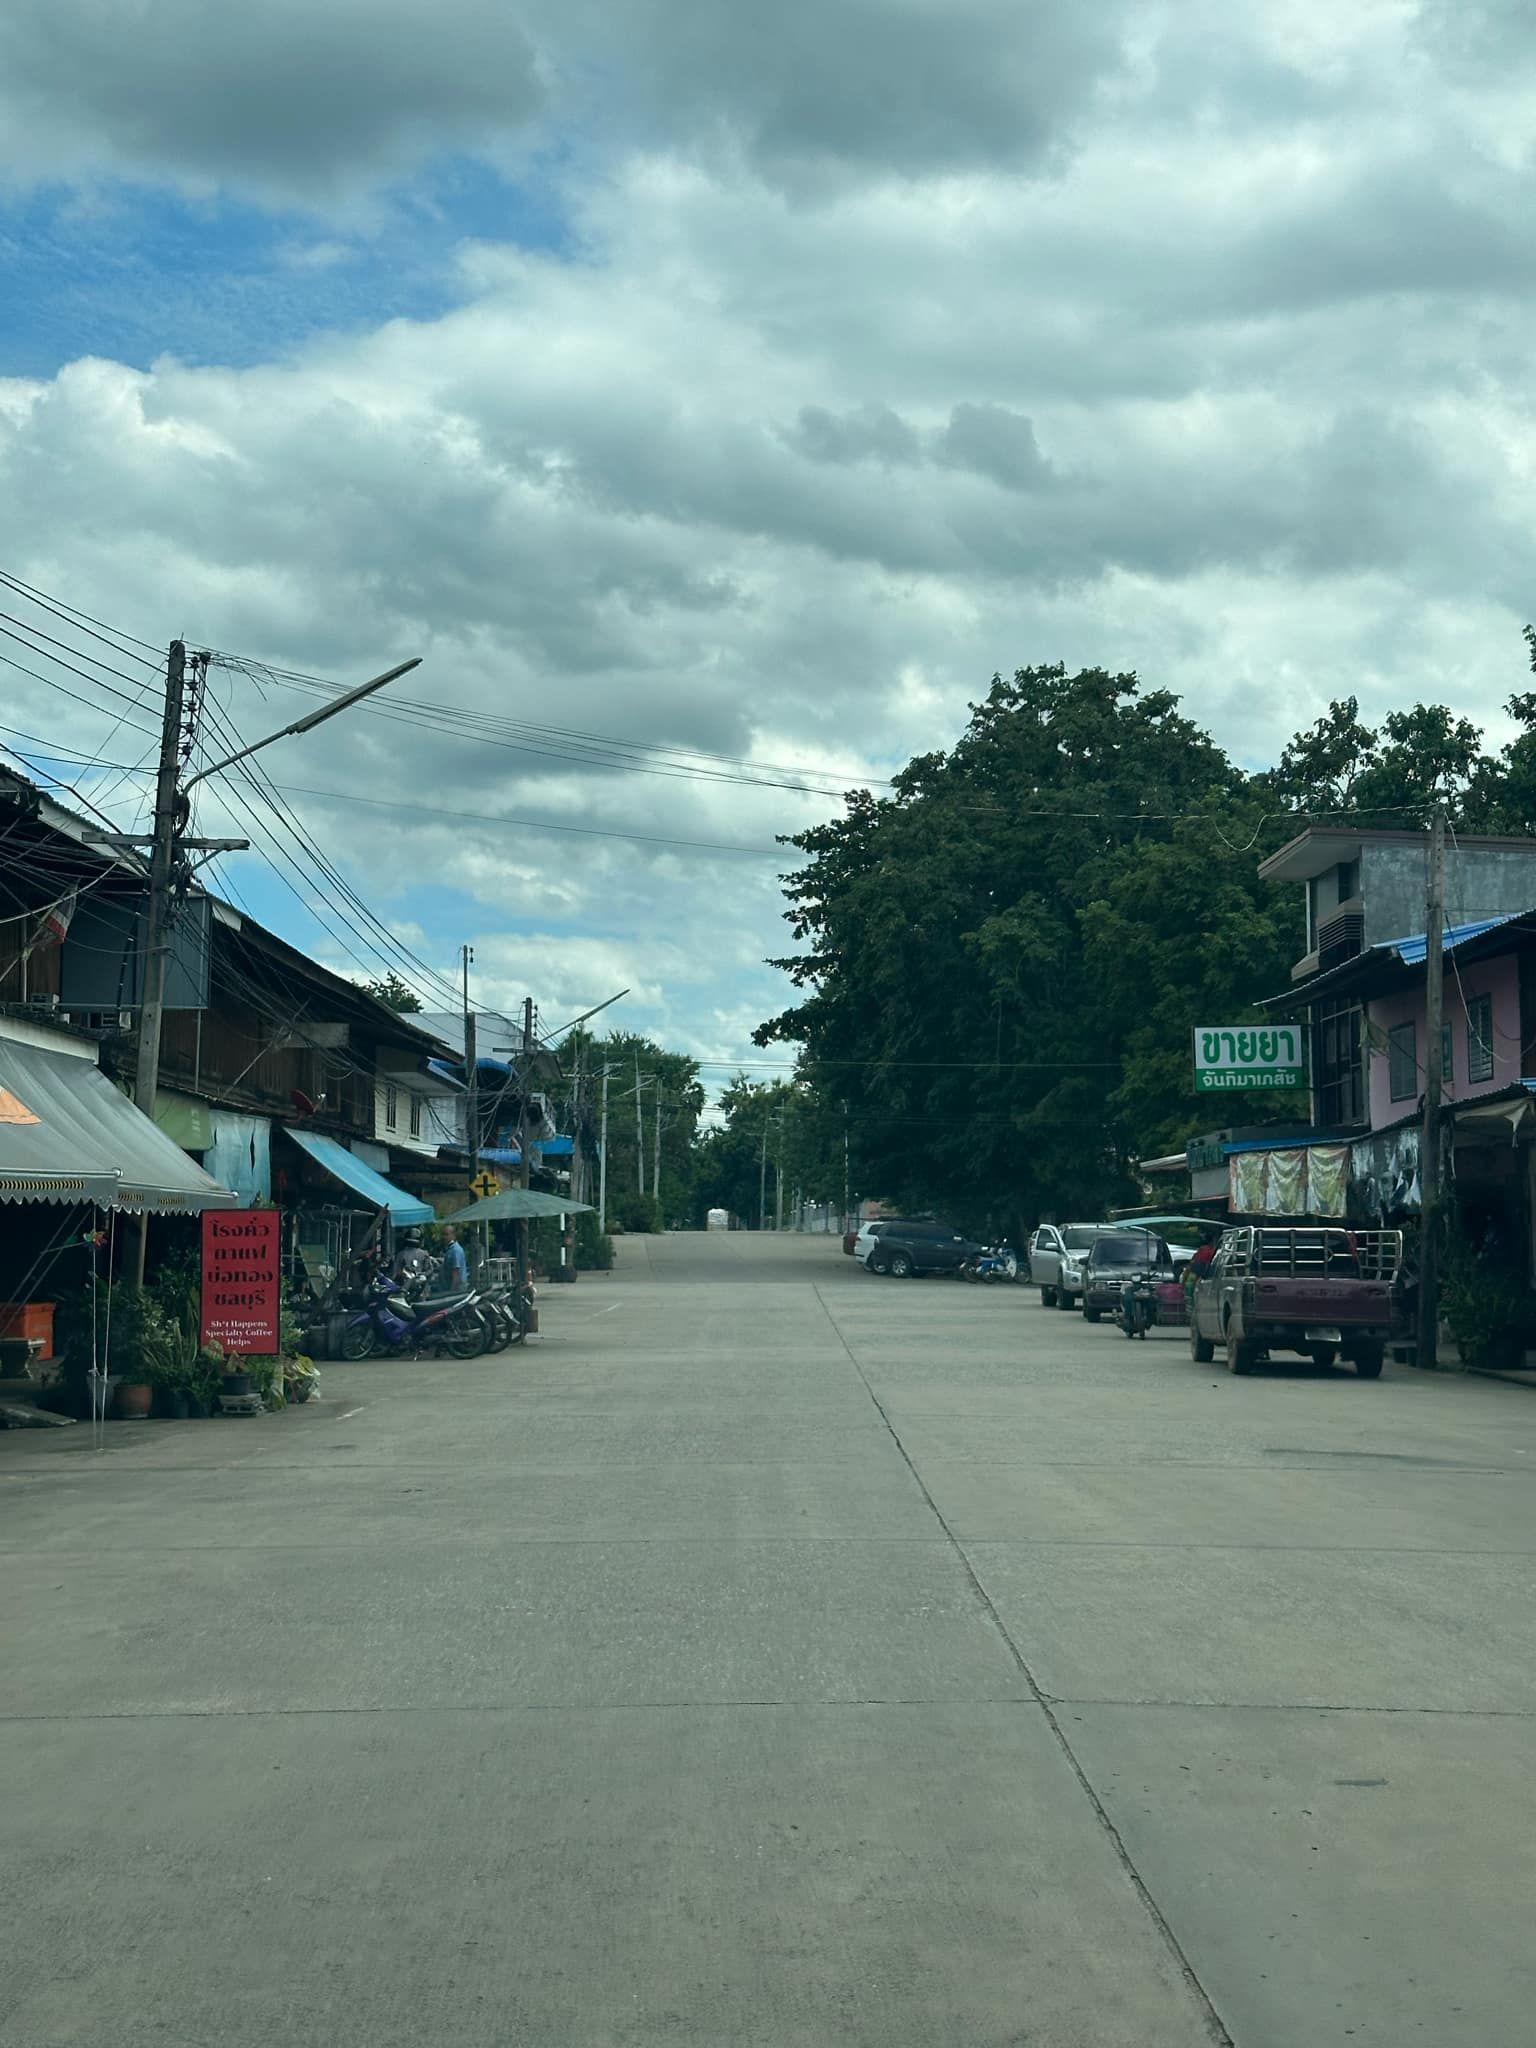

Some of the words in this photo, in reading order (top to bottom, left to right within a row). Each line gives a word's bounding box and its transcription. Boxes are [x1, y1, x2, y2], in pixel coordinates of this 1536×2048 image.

[1202, 1030, 1294, 1064] ขายยา
[1202, 1069, 1296, 1087] จันทิมาเภสัช
[209, 1216, 270, 1237] โรงคั่ว
[214, 1244, 267, 1260] กาแฟ
[207, 1265, 273, 1282] บ่อทอง
[214, 1289, 265, 1310] ชลบุรี
[231, 1320, 268, 1329] Happens
[205, 1329, 242, 1338] Specialty
[227, 1338, 251, 1347] Helps
